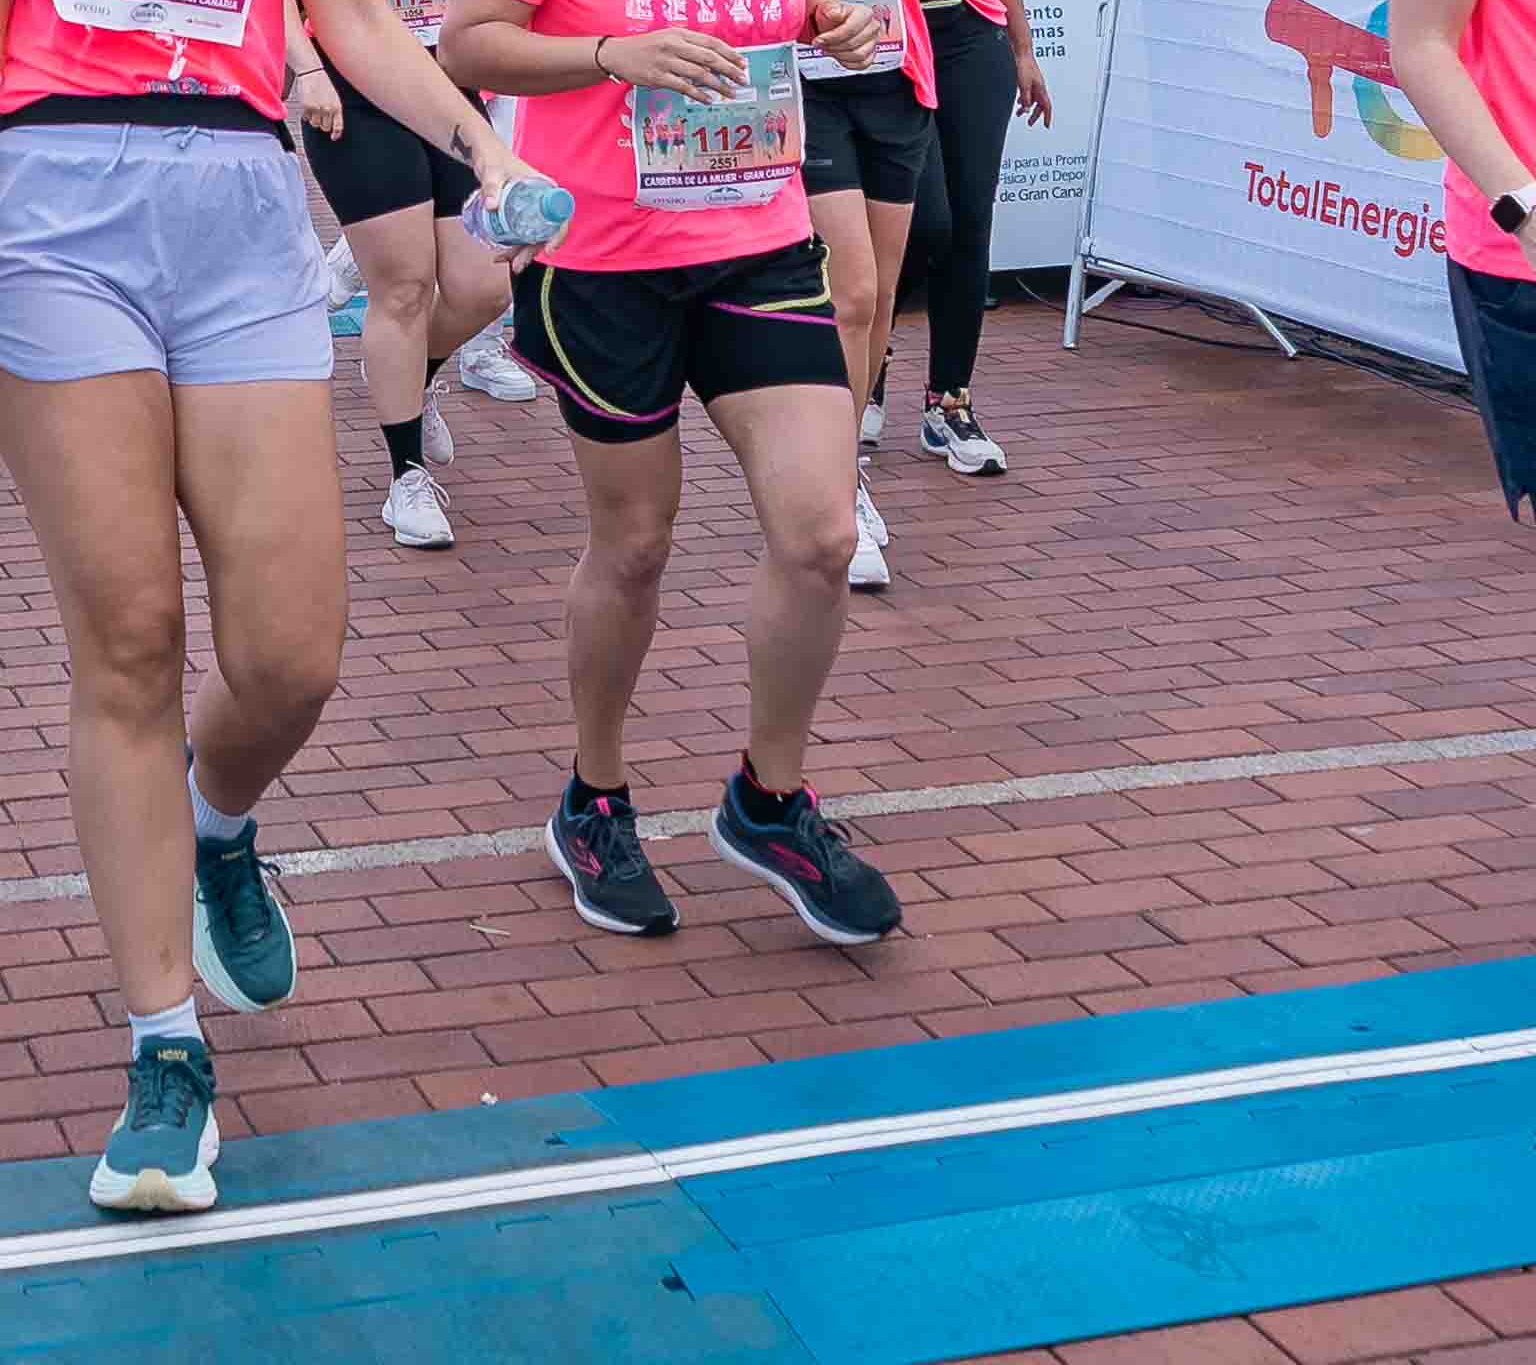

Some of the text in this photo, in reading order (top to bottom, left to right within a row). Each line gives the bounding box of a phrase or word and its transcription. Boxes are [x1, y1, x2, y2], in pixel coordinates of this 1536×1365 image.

[691, 124, 753, 153] 112
[697, 173, 709, 185] LA
[1244, 161, 1448, 258] TotalEnergie
